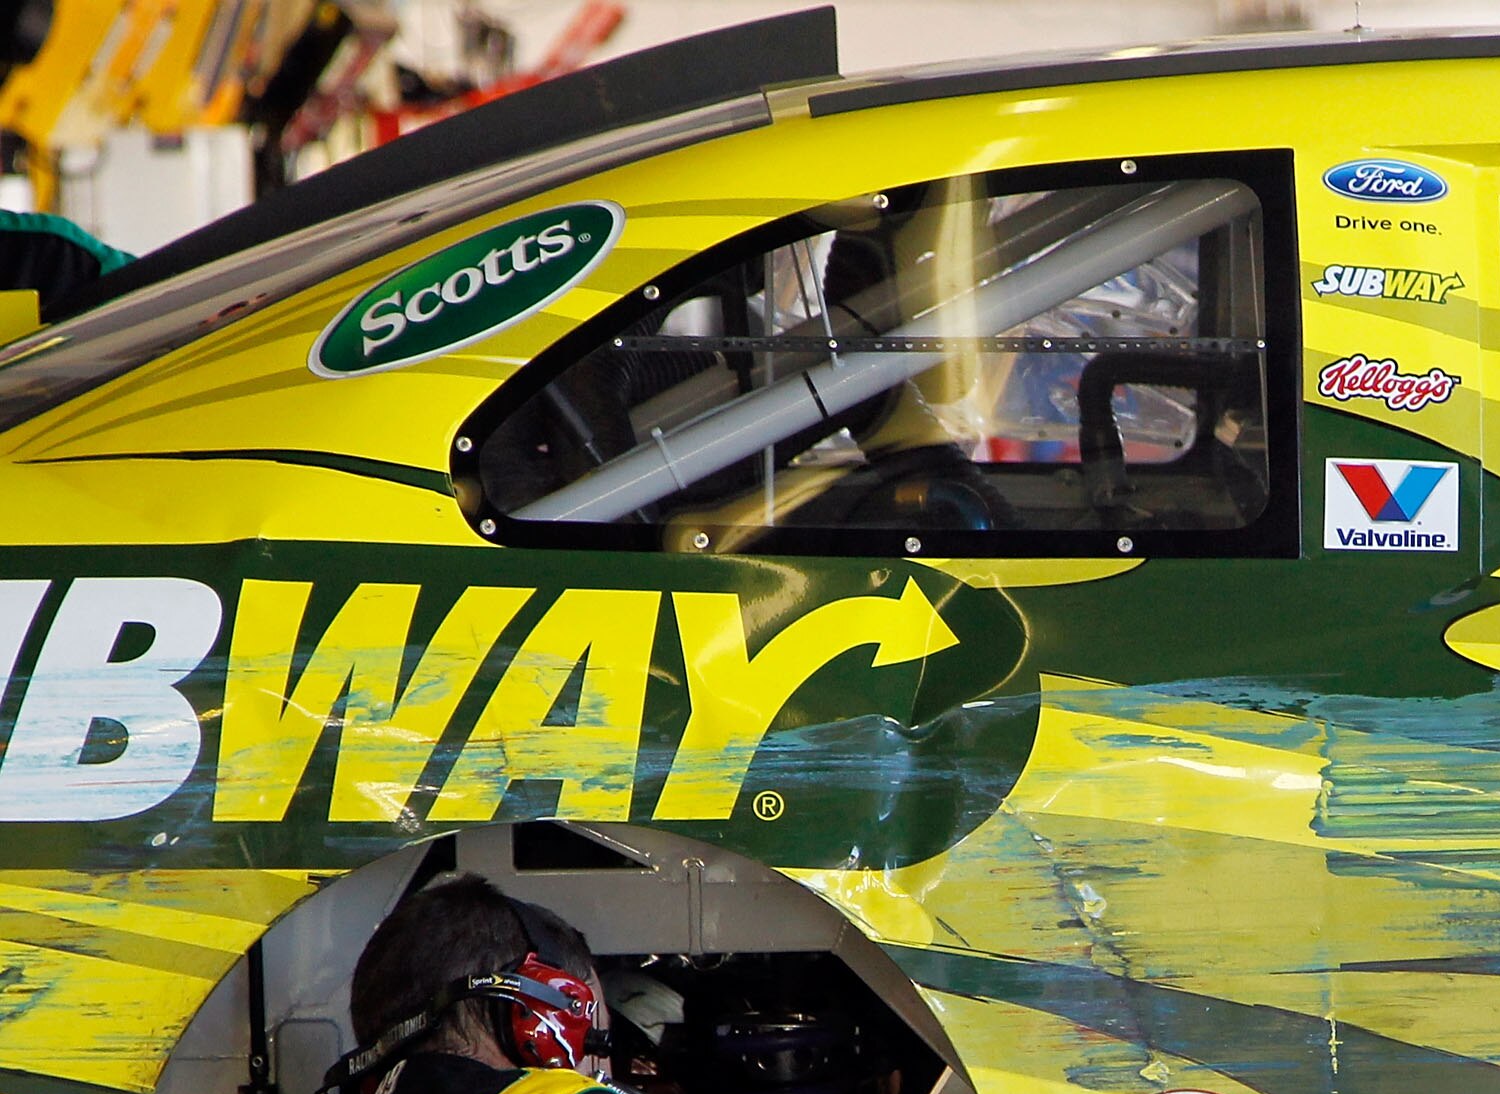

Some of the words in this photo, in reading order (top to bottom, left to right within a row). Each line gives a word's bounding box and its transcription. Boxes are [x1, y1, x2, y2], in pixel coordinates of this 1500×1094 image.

[1348, 164, 1424, 196] Ford
[1335, 215, 1392, 231] Drive
[1399, 220, 1443, 236] one.
[360, 220, 576, 358] Scotts
[1311, 264, 1466, 304] SUBWAY
[1324, 359, 1450, 405] Kellogg's
[1336, 527, 1451, 548] Valvoline
